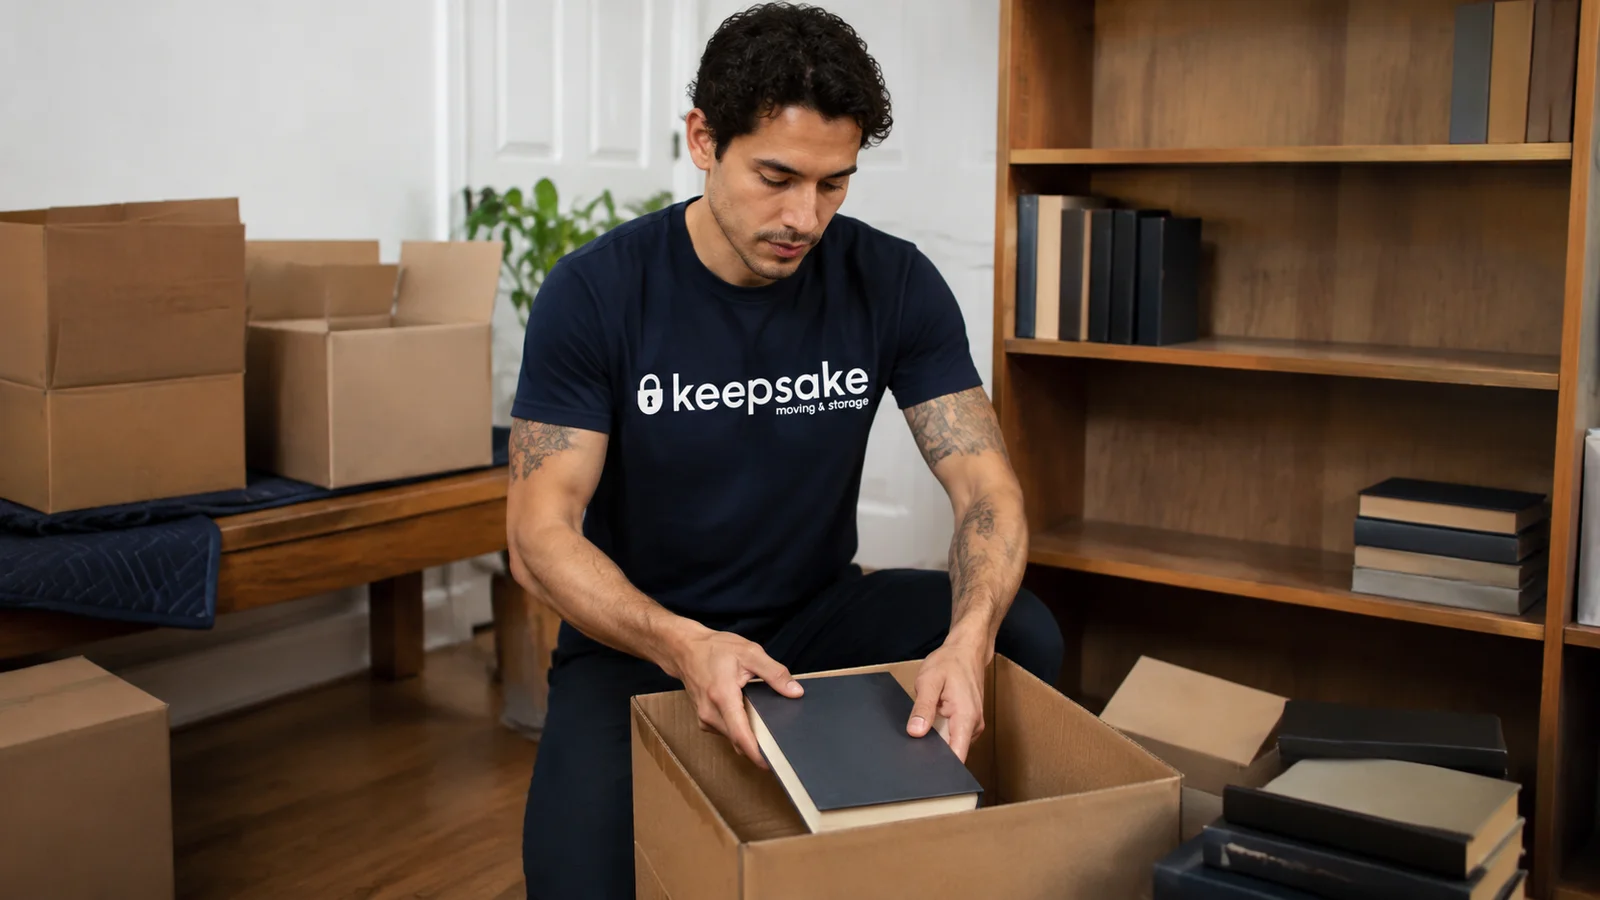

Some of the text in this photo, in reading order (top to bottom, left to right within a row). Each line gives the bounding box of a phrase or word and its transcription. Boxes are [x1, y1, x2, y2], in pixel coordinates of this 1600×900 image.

[672, 360, 869, 415] keepsake
[776, 397, 869, 415] moving & storage
